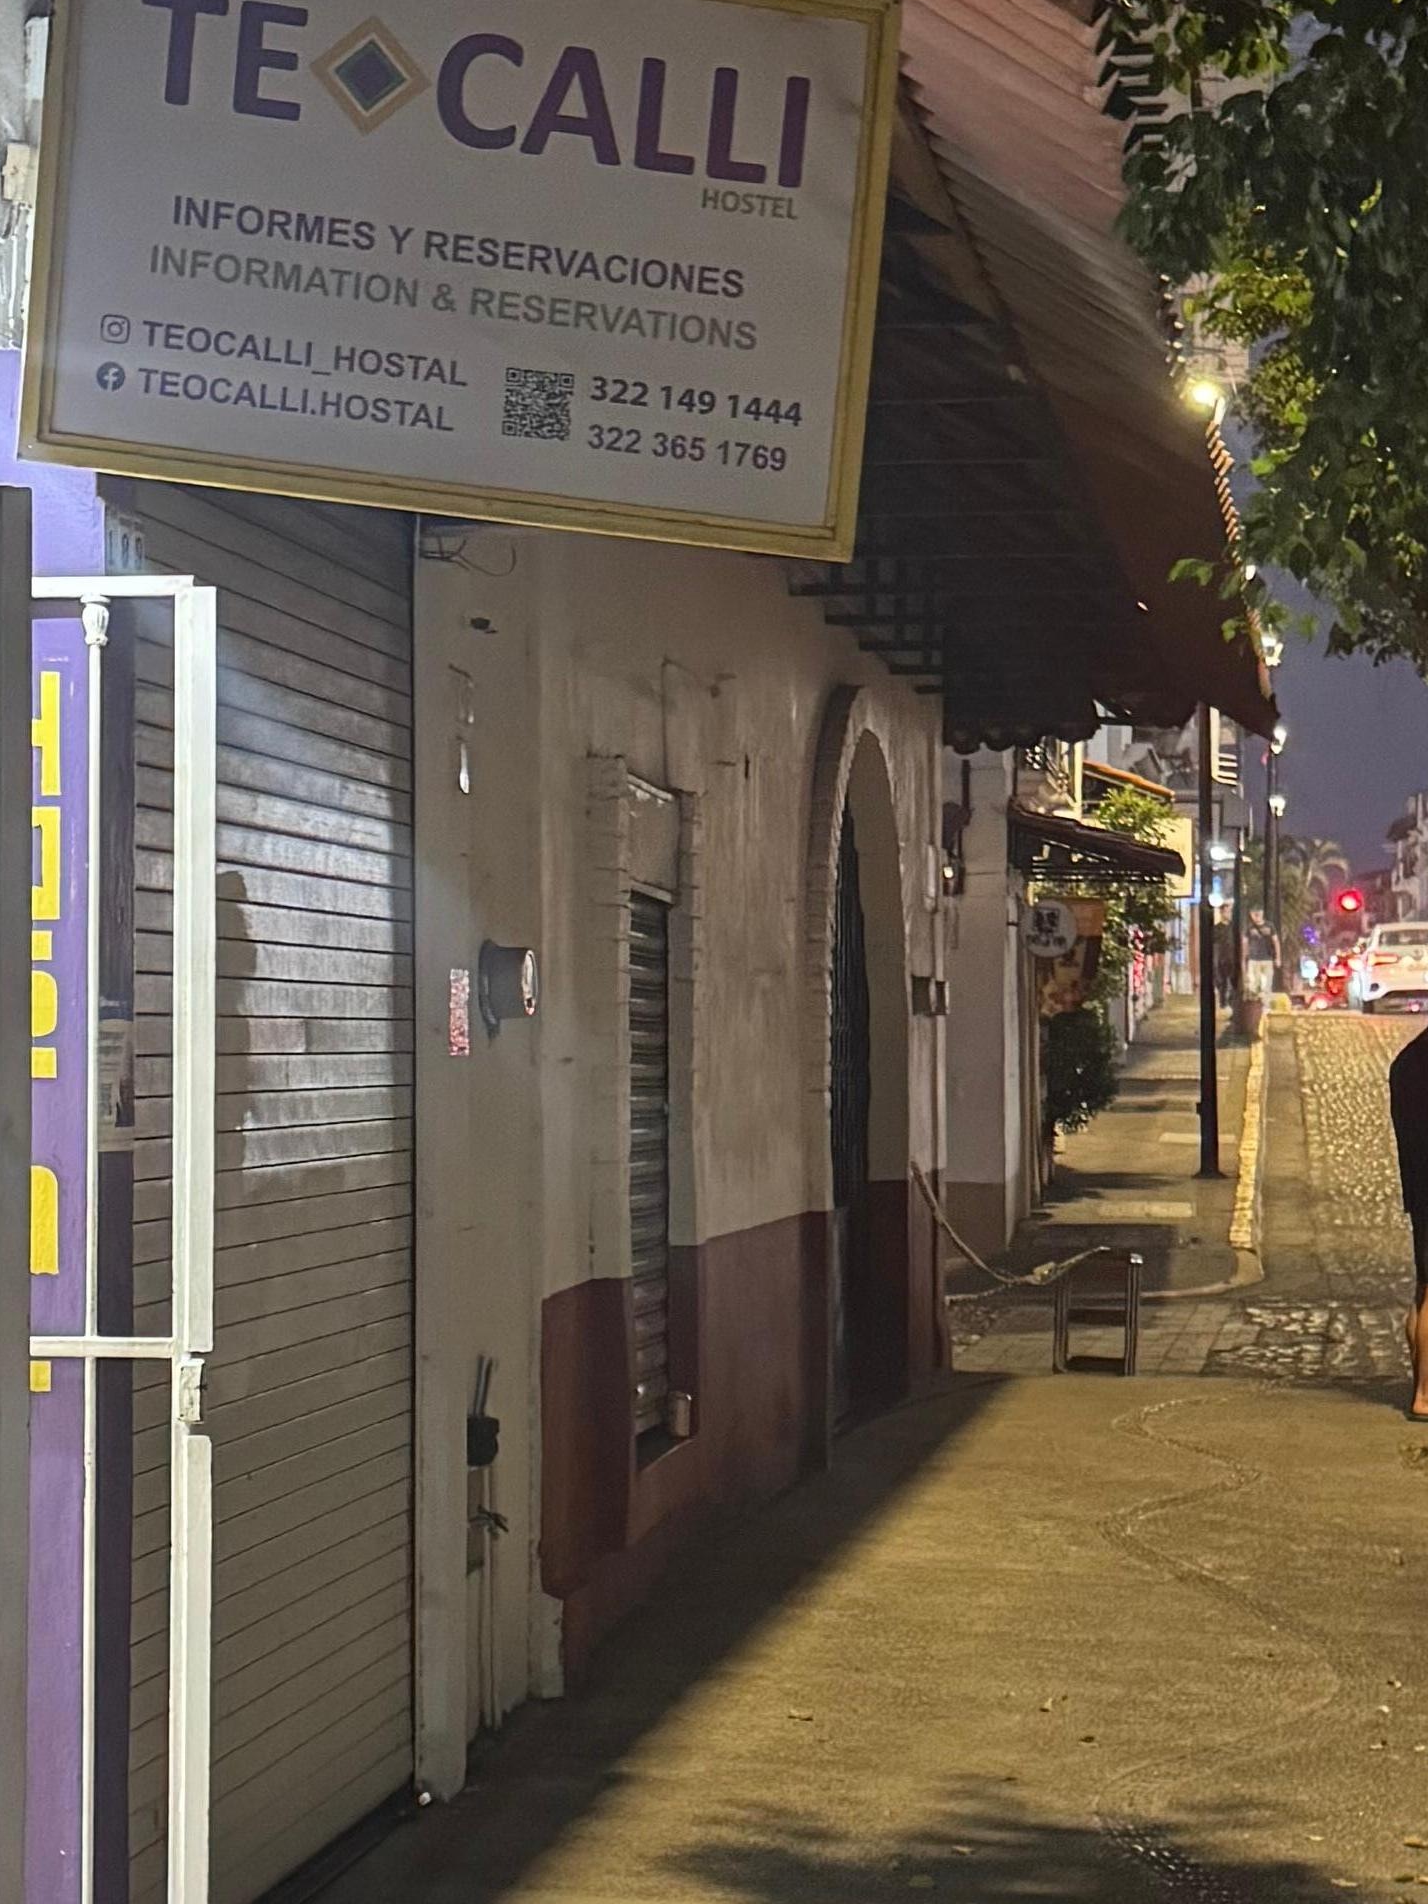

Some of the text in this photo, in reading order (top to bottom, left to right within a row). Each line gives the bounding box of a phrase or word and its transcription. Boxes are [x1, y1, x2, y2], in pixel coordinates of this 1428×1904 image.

[700, 186, 800, 222] HOSTEL
[172, 194, 746, 300] INFORMES Y RESERVACIONES
[149, 243, 759, 352] INFORMATION & RESERVATIONS
[141, 318, 470, 389] TEOCALLI_HOSTAL
[137, 367, 456, 433] TEOCALLI.HOSTAL
[589, 374, 804, 429] 322 149 1444
[586, 423, 789, 473] 322 365 1769
